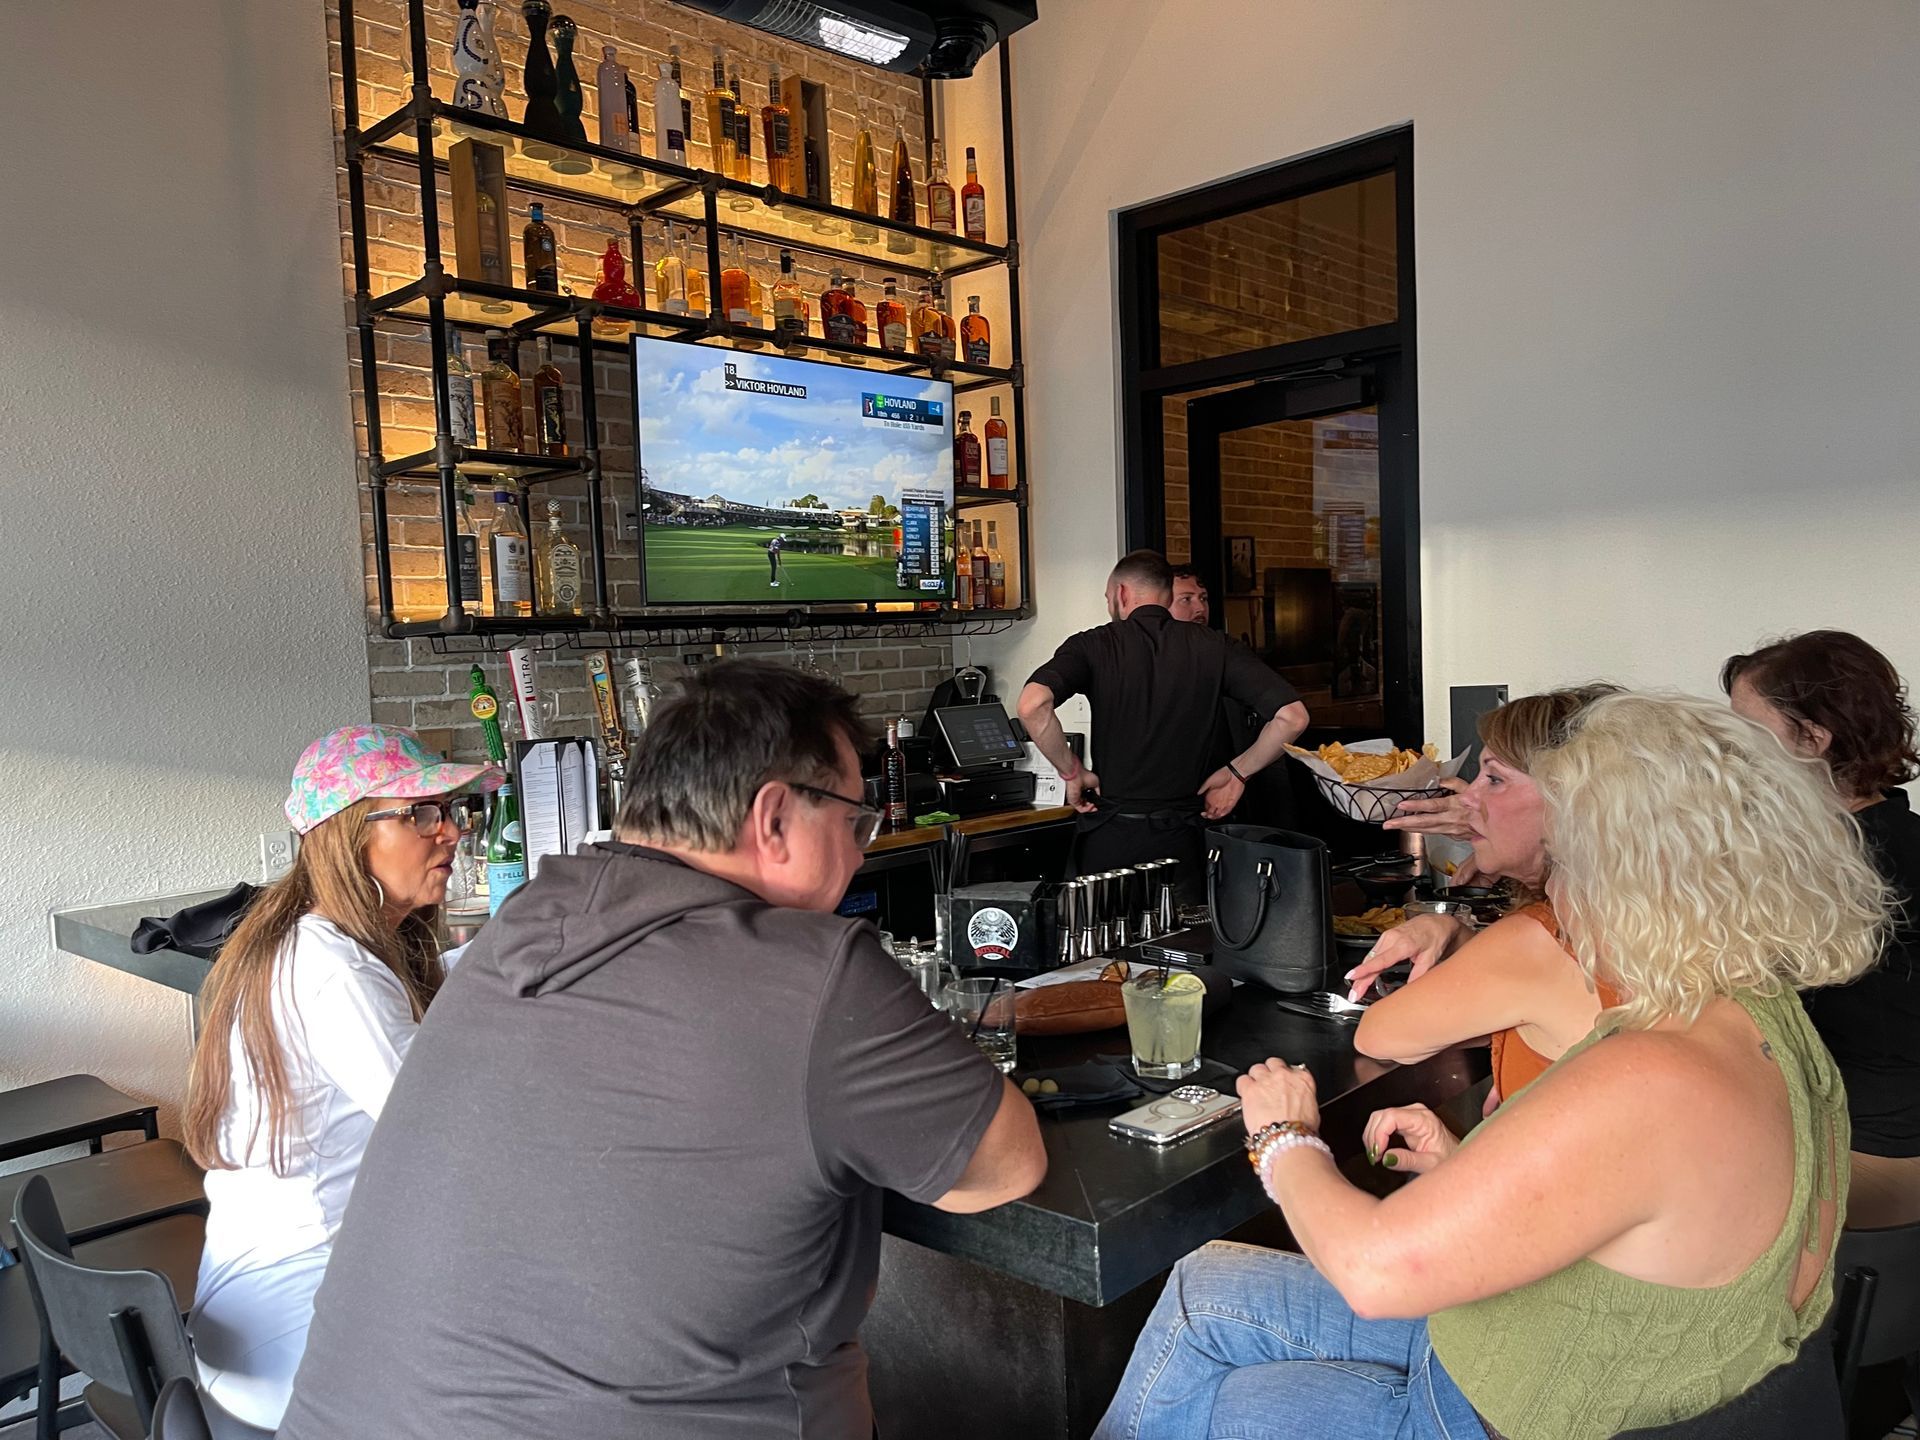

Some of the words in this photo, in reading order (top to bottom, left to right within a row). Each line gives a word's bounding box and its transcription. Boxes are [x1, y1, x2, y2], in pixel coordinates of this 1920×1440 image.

[736, 379, 766, 393] VIKTOR
[884, 397, 917, 410] HOVLAND
[520, 654, 534, 694] ULTRA
